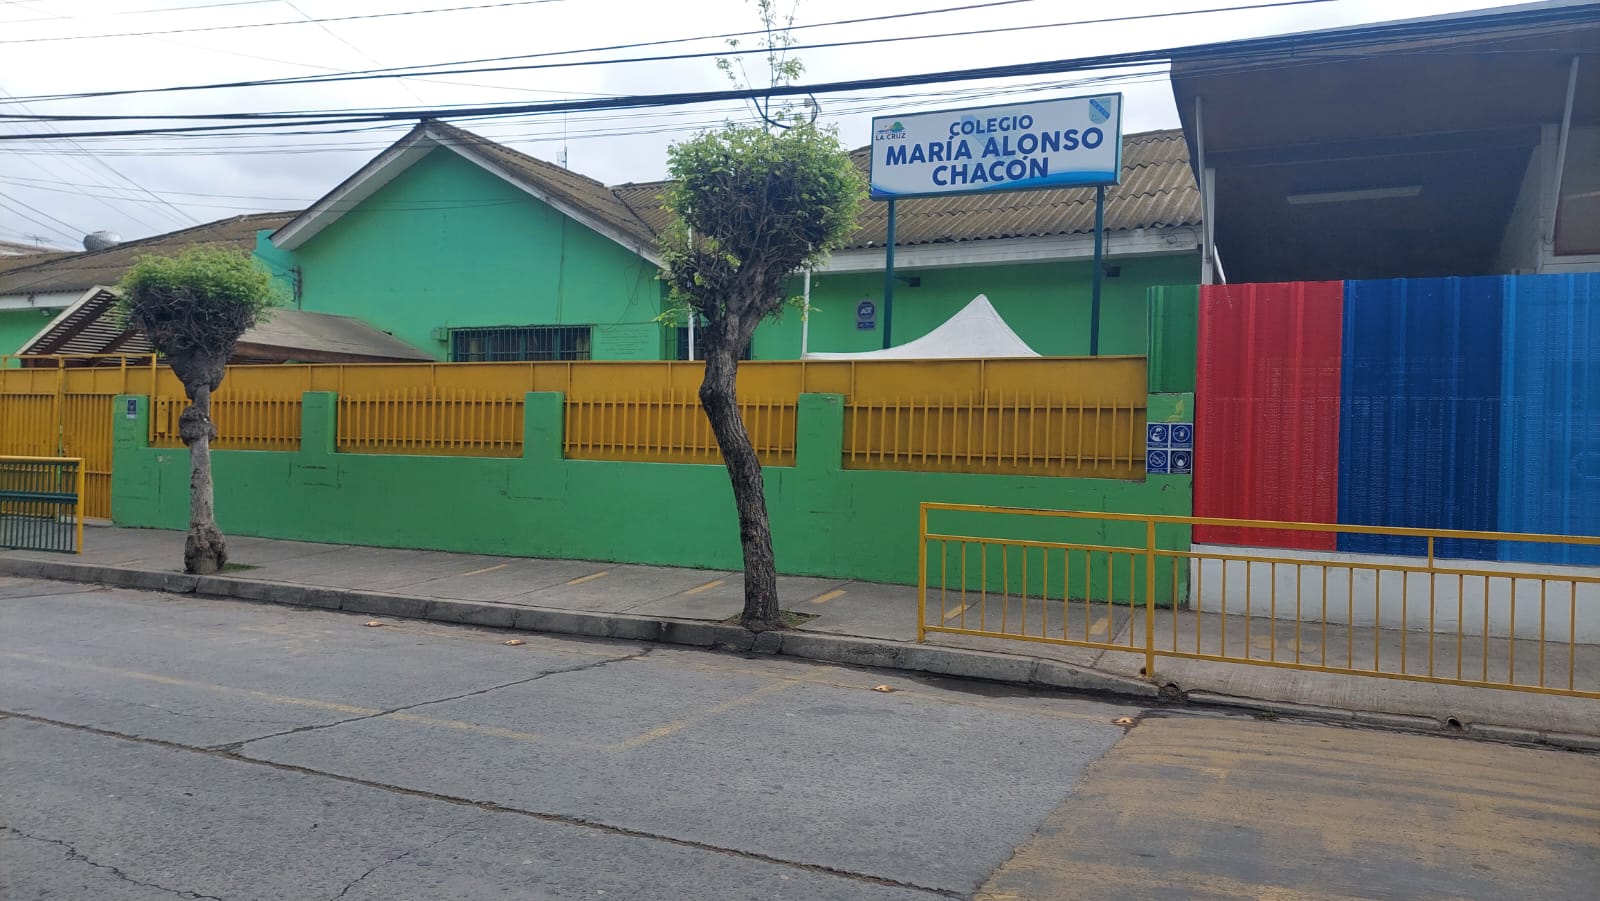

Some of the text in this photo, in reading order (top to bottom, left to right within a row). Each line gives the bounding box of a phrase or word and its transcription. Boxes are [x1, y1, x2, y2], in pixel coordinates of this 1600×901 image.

[950, 115, 1034, 136] COLEGIO
[886, 127, 1104, 166] MARÍA ALONSO
[932, 155, 1049, 186] CHACÓN
